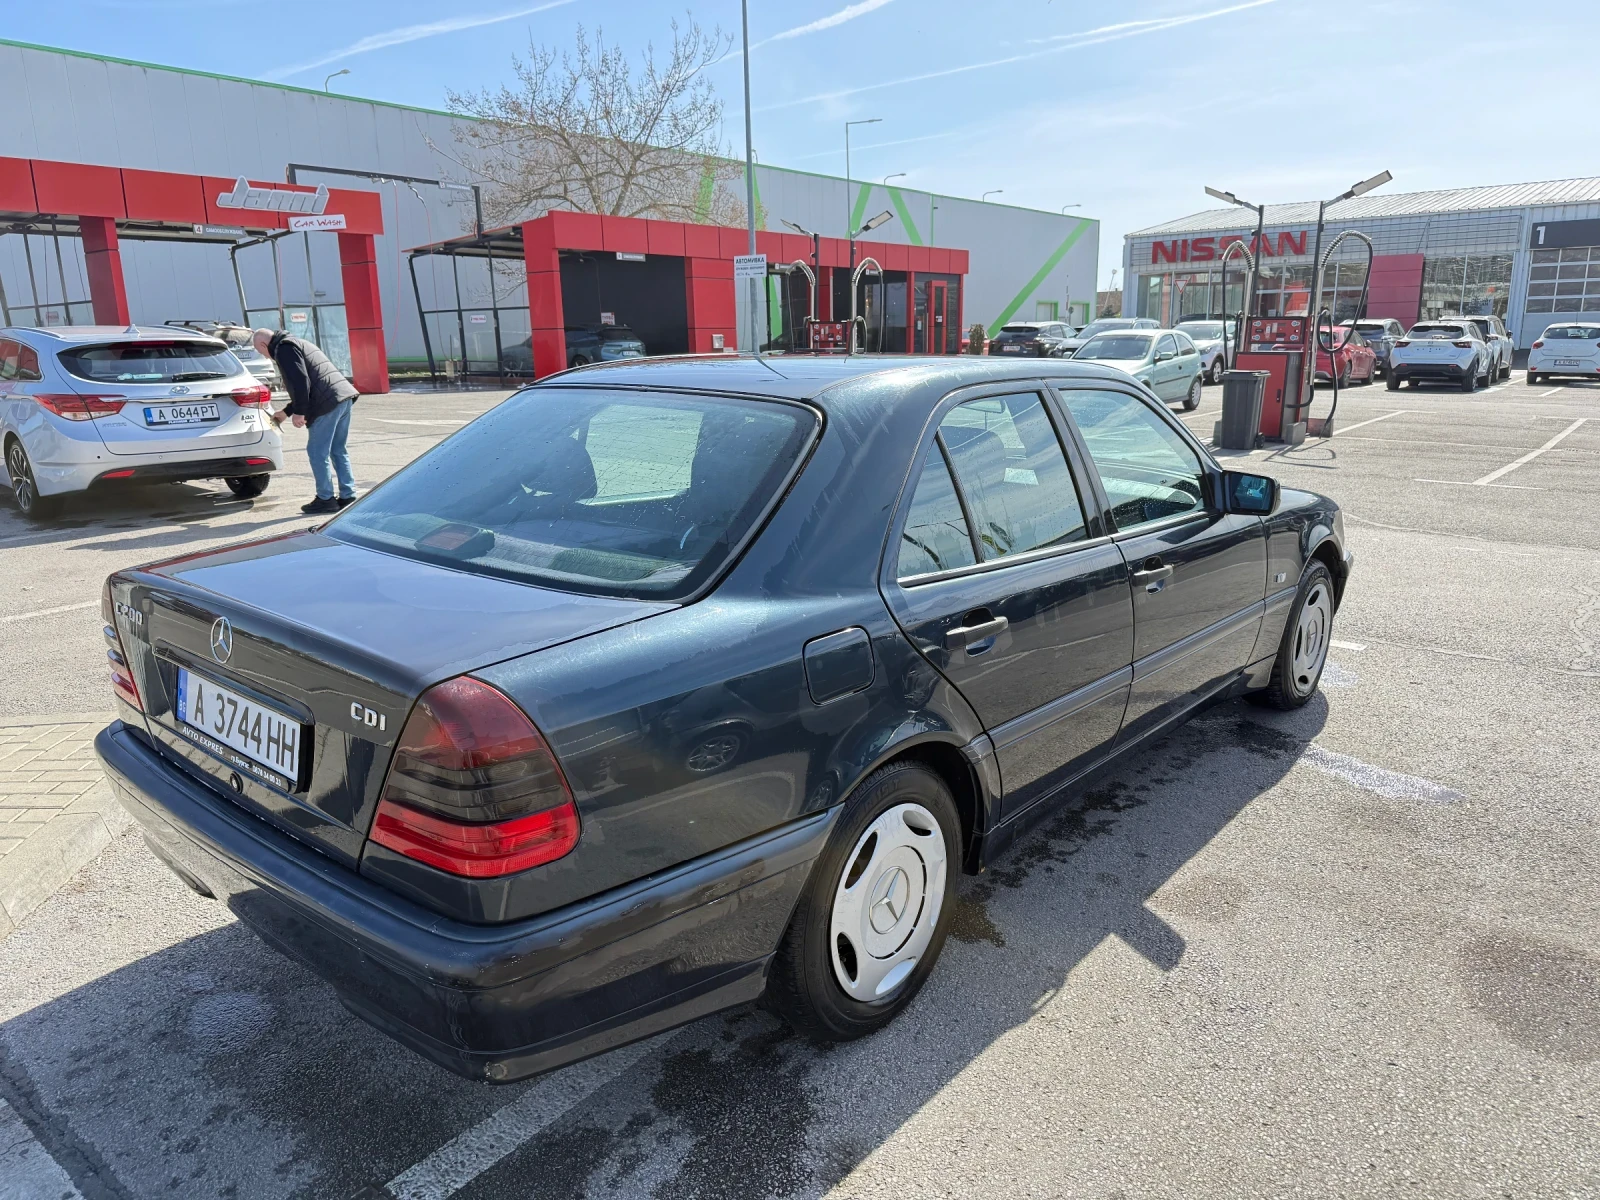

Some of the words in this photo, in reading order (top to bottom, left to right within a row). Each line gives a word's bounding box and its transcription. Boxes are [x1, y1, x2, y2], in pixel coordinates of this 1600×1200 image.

[294, 219, 314, 228] CAR
[316, 218, 343, 227] WASH
[1536, 226, 1546, 245] 1
[1151, 230, 1308, 264] NISSAN
[158, 409, 166, 421] A
[194, 683, 205, 726] A
[350, 701, 386, 731] CDI
[182, 726, 200, 742] AVTO
[199, 737, 224, 756] EXPRES
